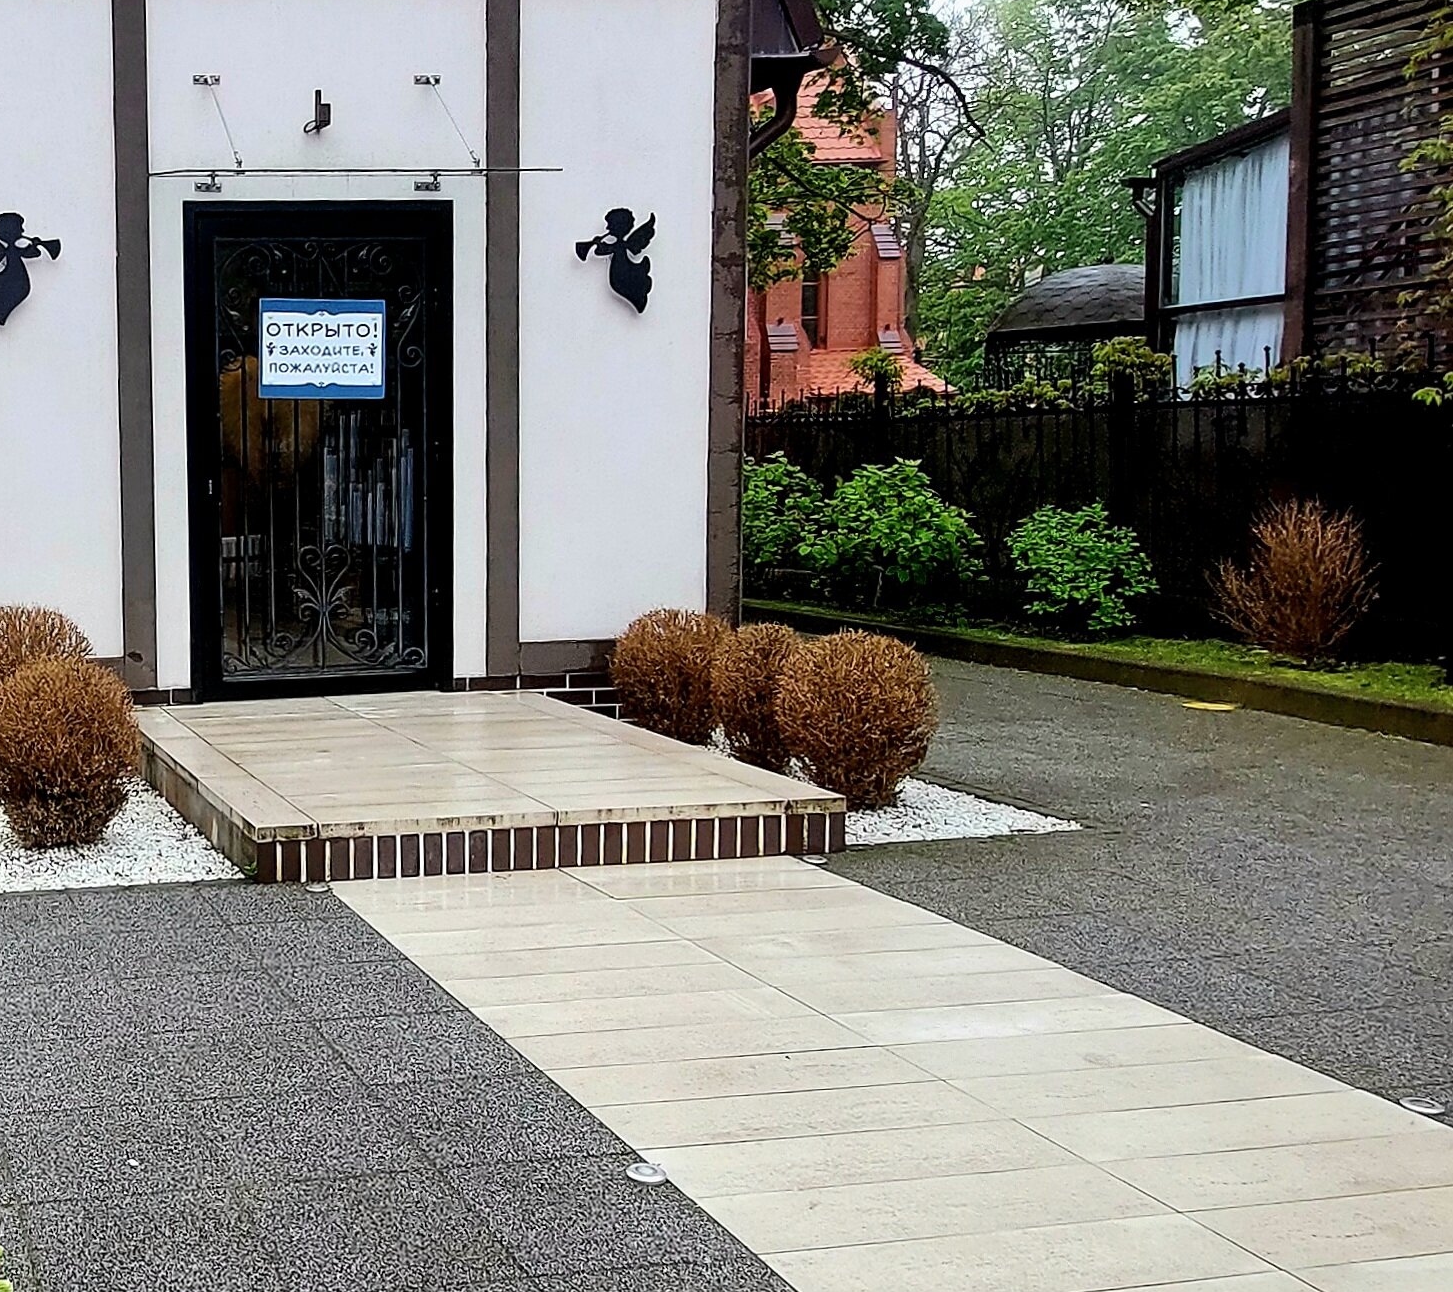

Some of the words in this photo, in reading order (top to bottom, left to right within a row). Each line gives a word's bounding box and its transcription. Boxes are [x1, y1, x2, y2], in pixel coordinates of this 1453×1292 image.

[266, 322, 378, 339] ОТКРЫТО!
[279, 345, 364, 357] ЗАХОДИТЕ,
[269, 362, 375, 374] ПОЖАЛУЙСТА!
